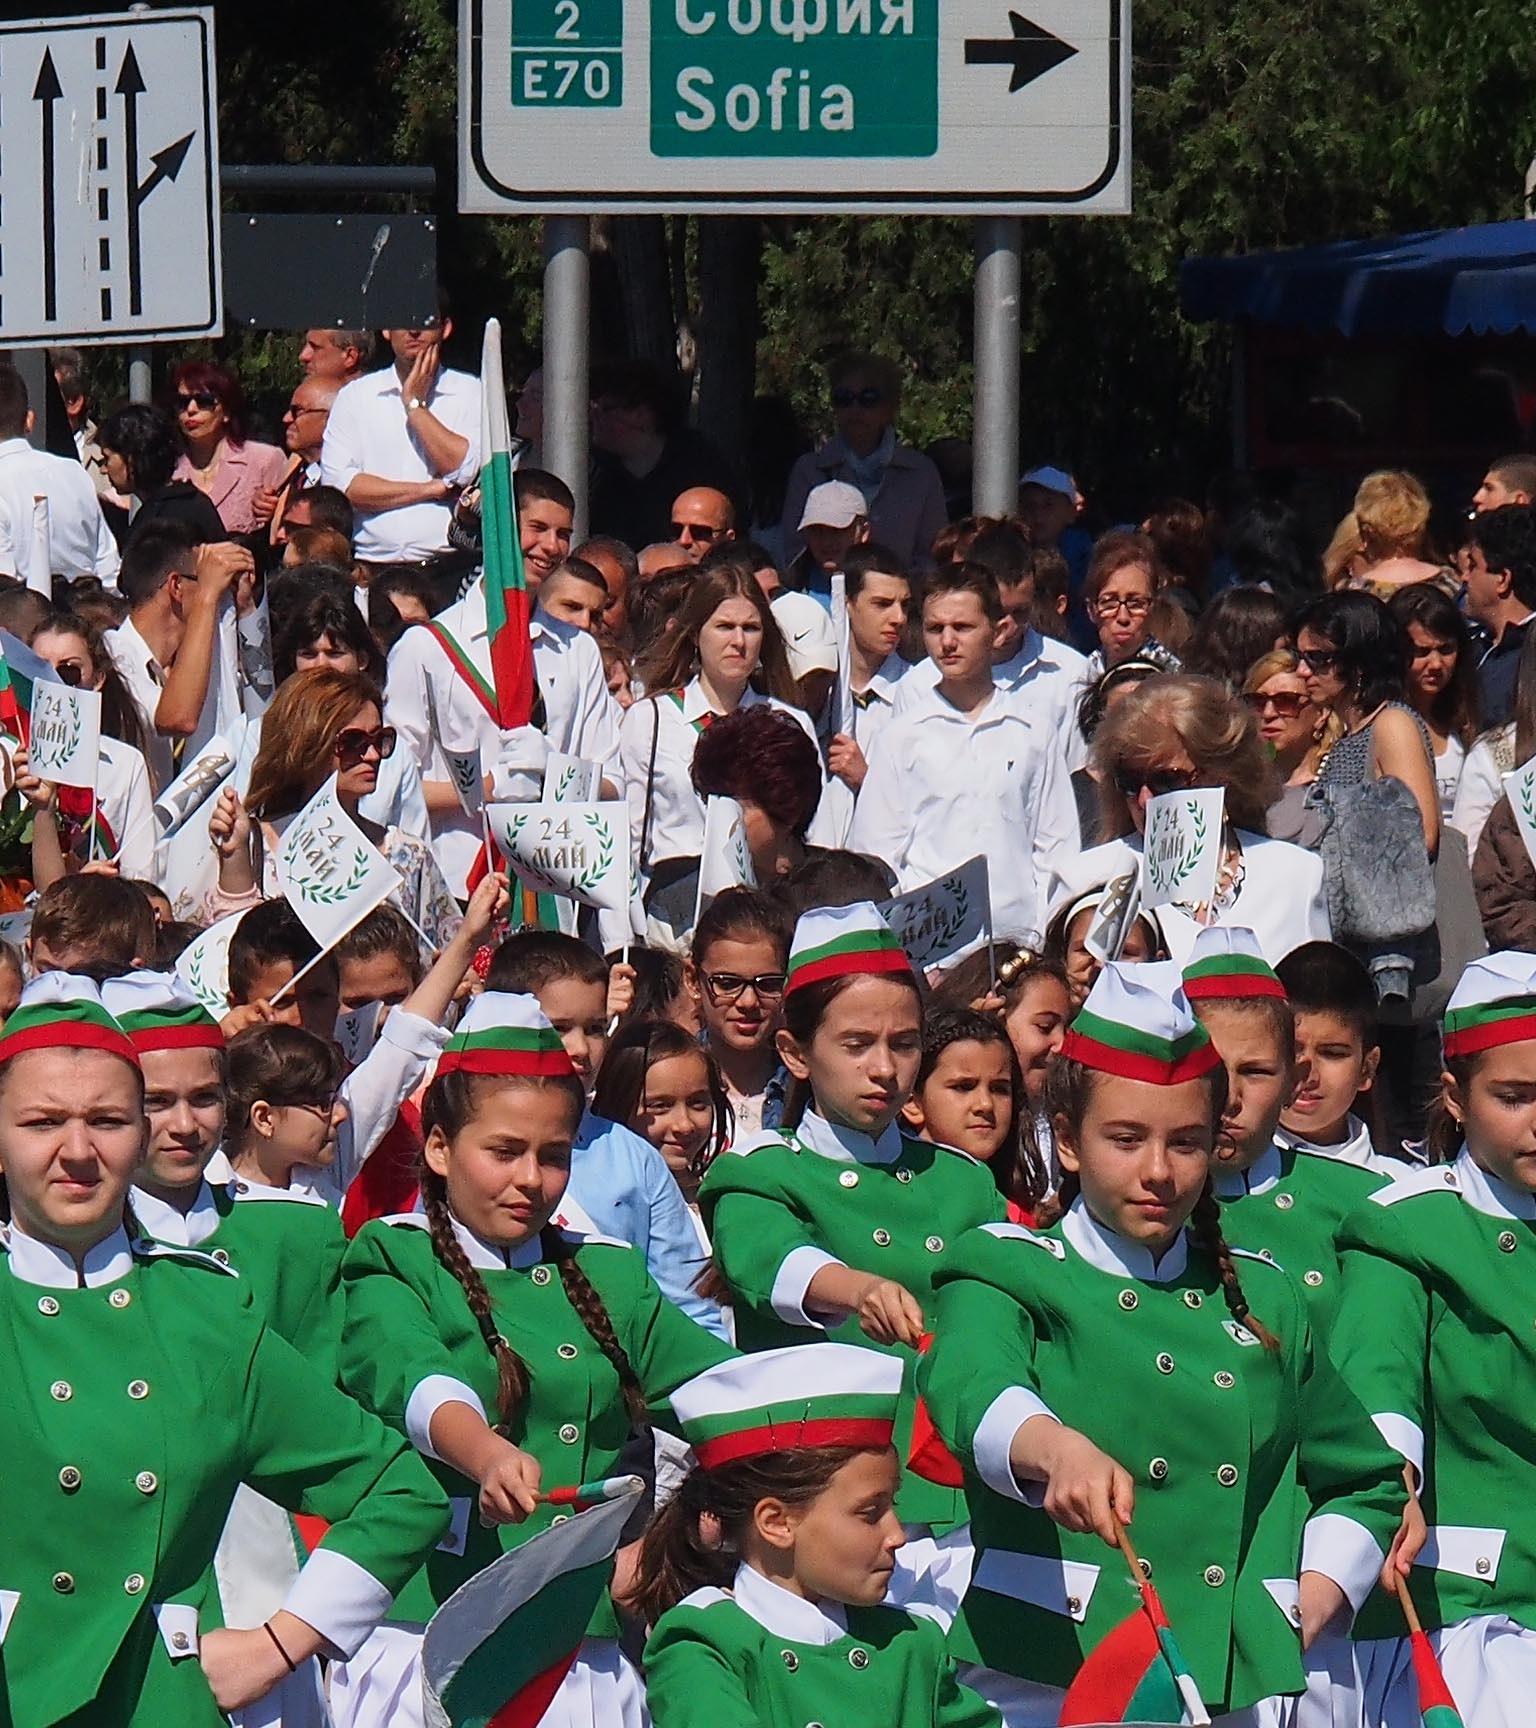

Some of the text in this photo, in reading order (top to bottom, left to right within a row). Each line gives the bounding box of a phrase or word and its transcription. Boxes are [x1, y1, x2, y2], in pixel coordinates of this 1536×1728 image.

[554, 1, 580, 40] 2
[523, 59, 610, 99] E70
[674, 65, 856, 132] Sofia
[44, 695, 62, 717] 24
[36, 718, 69, 745] МАЙ
[317, 815, 345, 849] 24
[539, 815, 572, 841] 24
[1164, 806, 1179, 831] 24
[298, 828, 340, 883] МАЙ
[531, 838, 586, 869] МАЙ
[1158, 828, 1185, 862] МАЙ
[903, 894, 932, 922] 24
